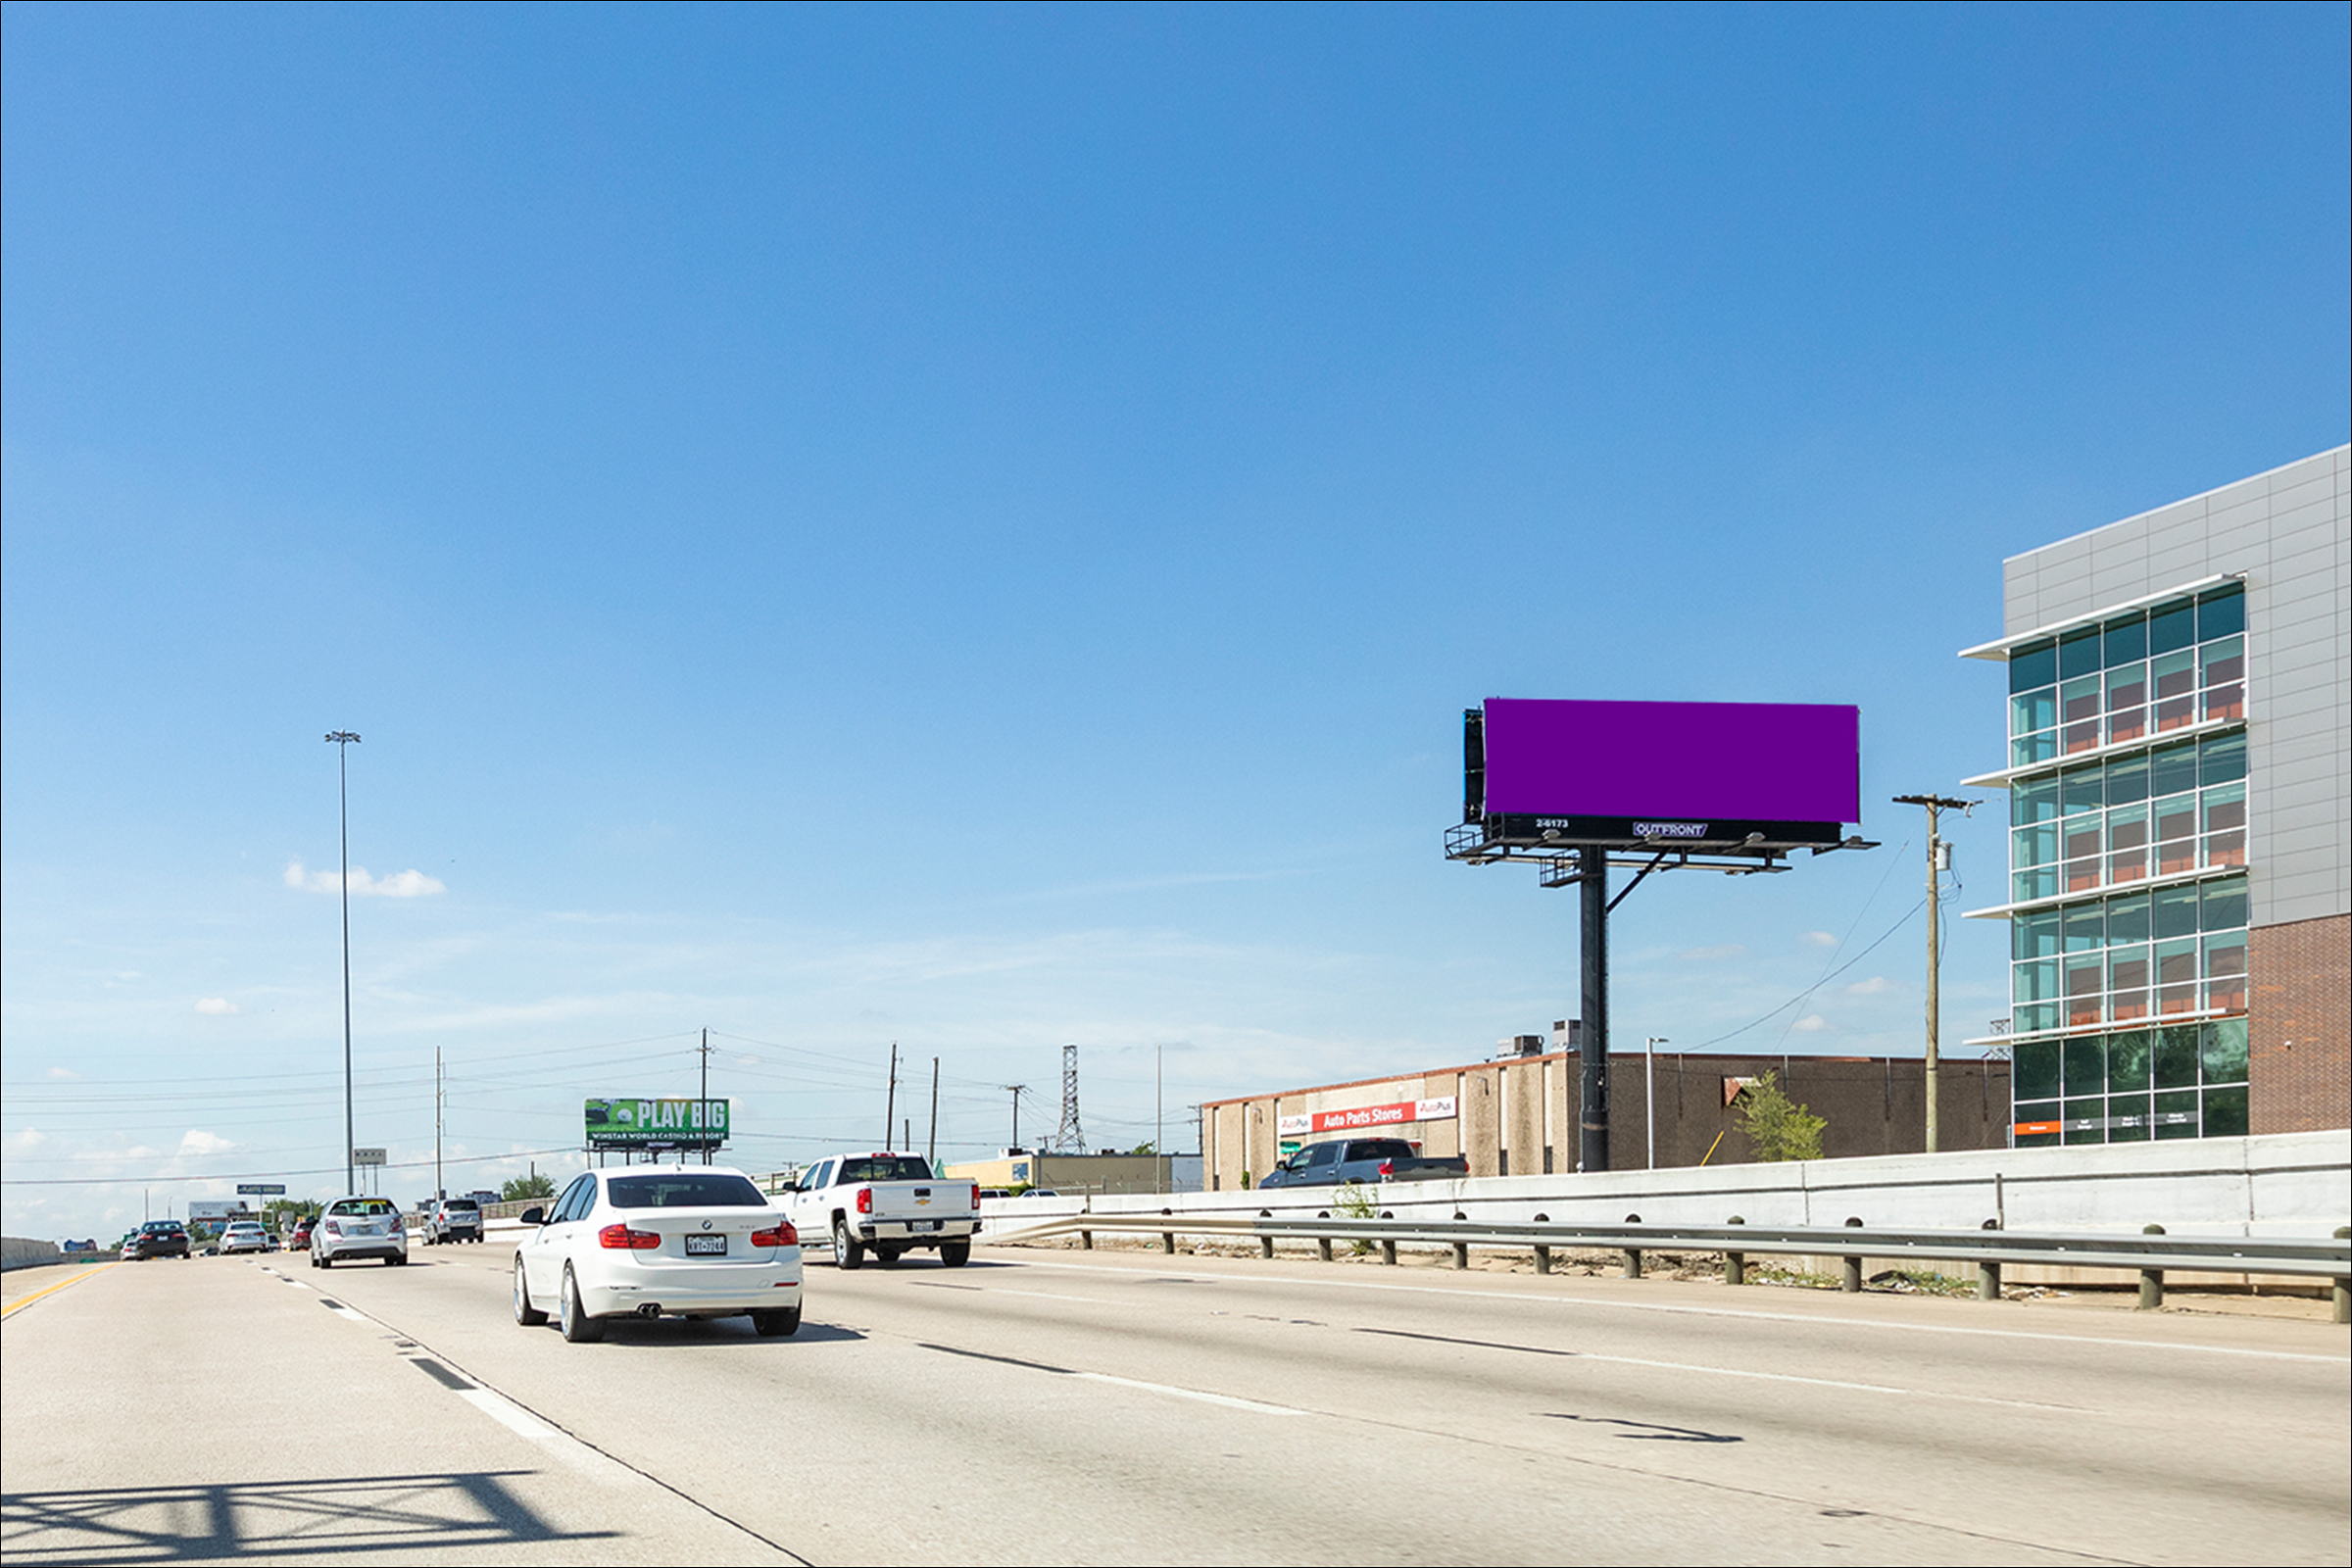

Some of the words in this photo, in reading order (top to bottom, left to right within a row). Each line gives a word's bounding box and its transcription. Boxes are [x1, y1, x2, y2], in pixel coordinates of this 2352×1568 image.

[1636, 823, 1702, 837] OUTFRONT
[638, 1102, 686, 1128] PLAY
[691, 1102, 725, 1128] BIG
[1324, 1114, 1345, 1128] Auto
[1347, 1111, 1370, 1125] Parts
[1372, 1108, 1403, 1123] Stores
